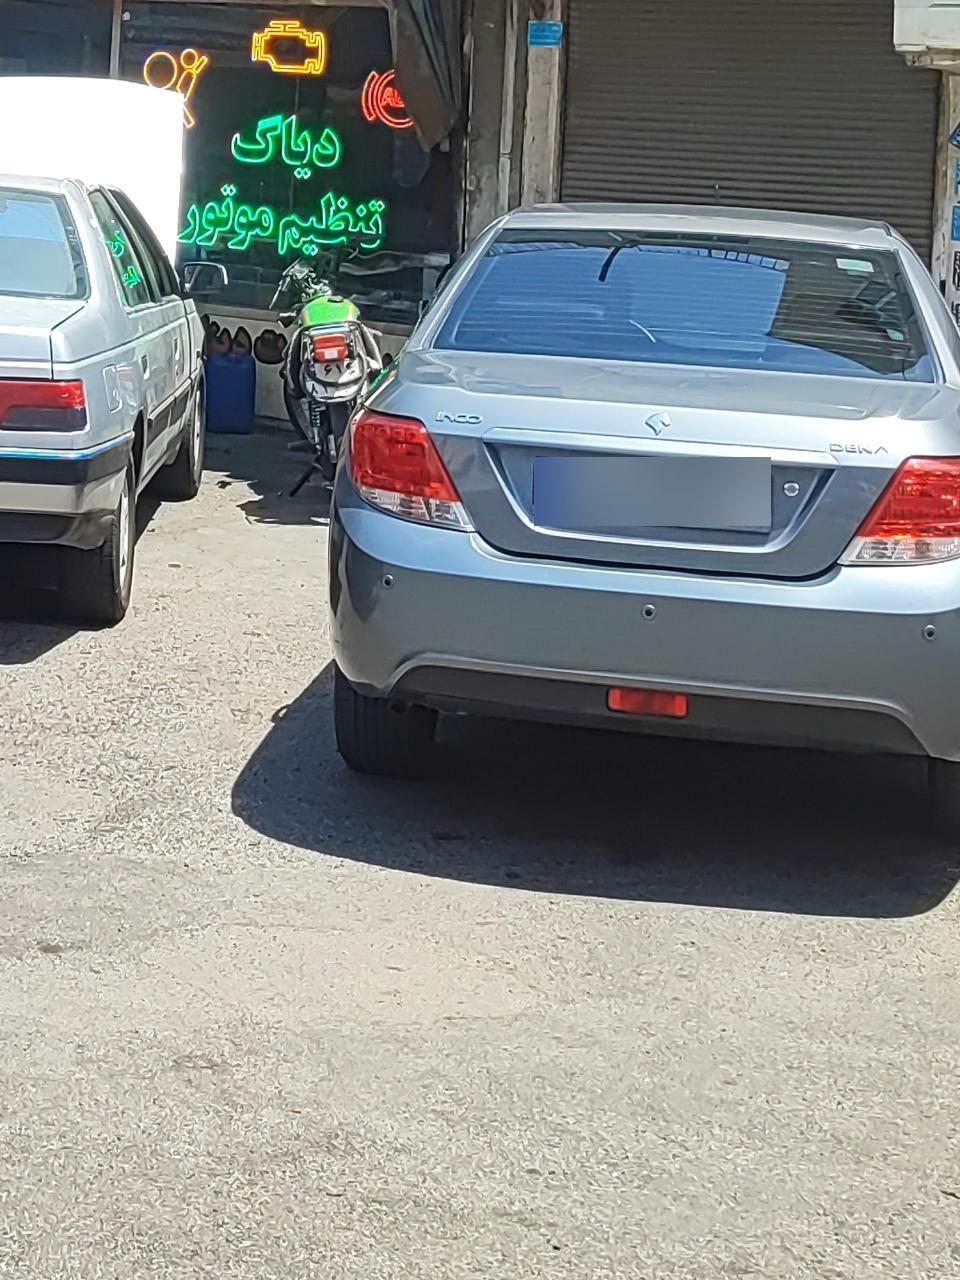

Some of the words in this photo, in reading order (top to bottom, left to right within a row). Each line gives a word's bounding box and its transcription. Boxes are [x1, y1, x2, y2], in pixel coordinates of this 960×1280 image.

[231, 114, 340, 179] دیاگ
[176, 183, 275, 251] موتور
[277, 191, 386, 256] تنظیم
